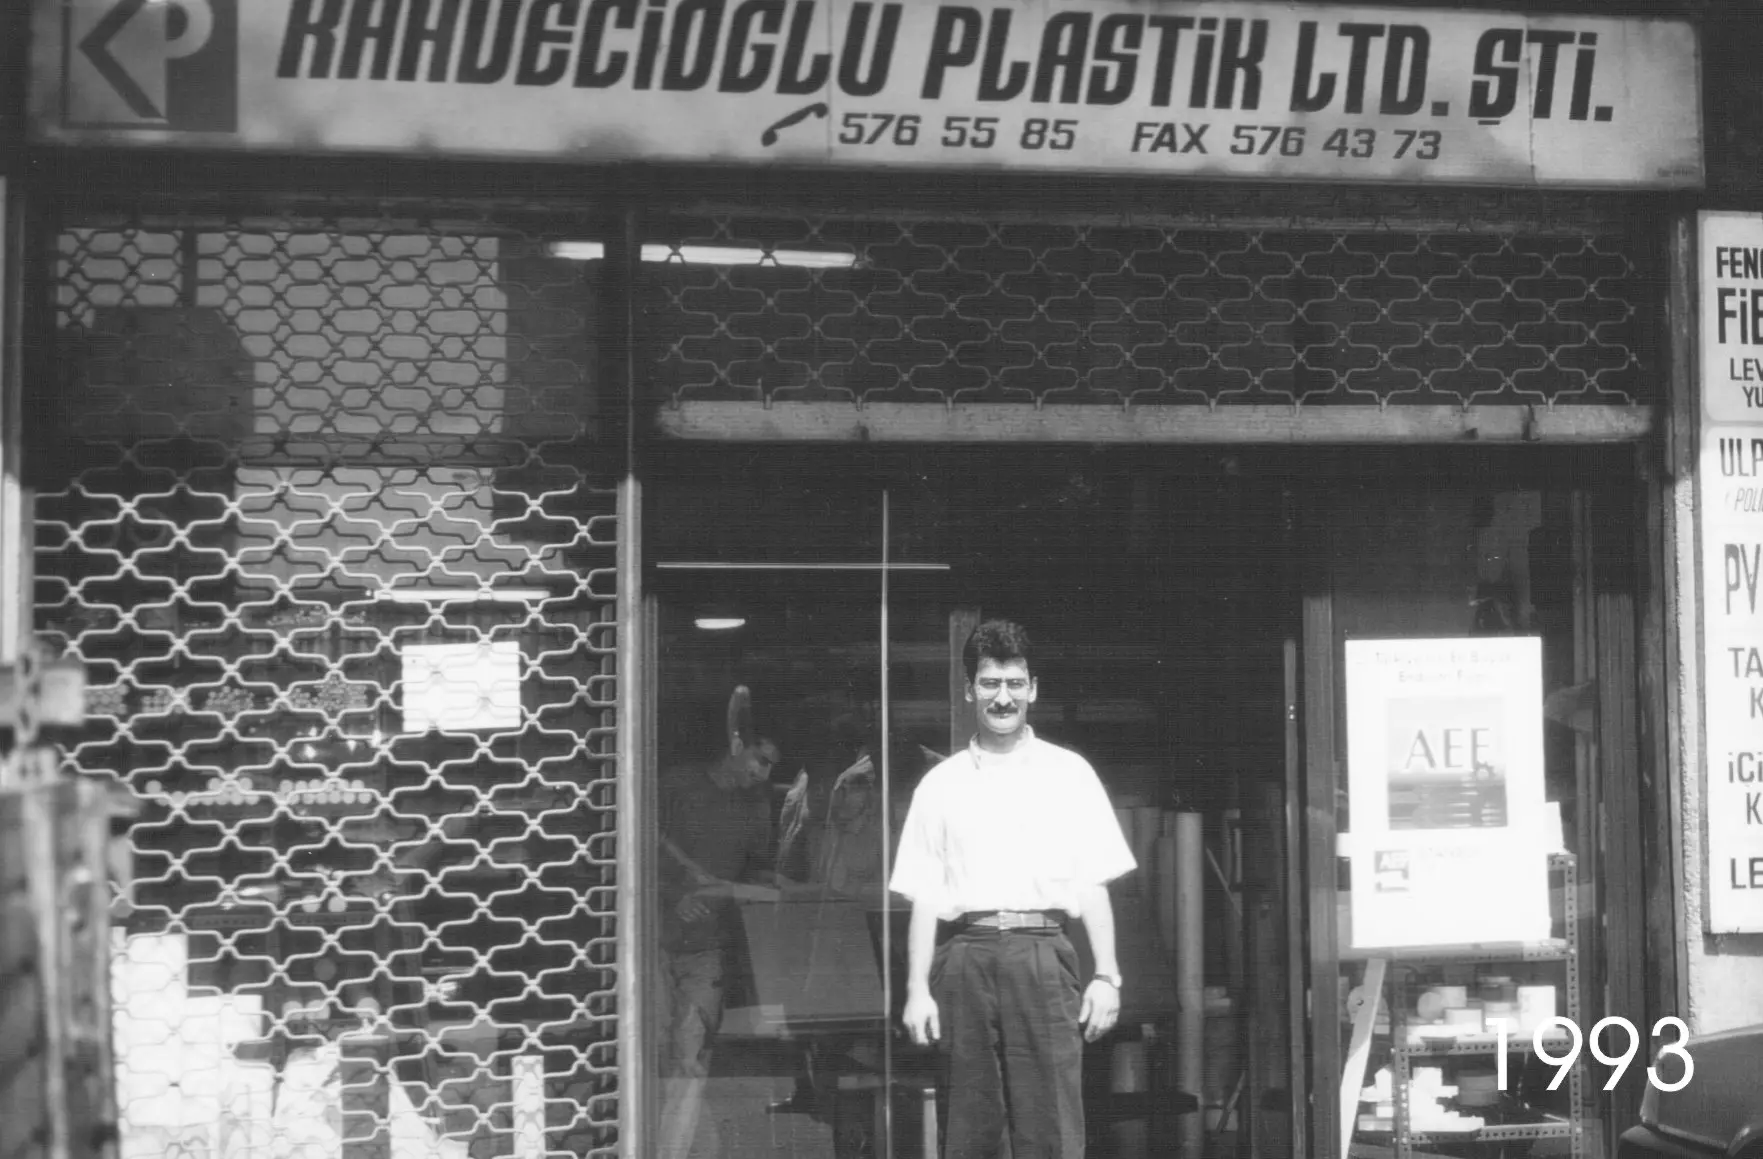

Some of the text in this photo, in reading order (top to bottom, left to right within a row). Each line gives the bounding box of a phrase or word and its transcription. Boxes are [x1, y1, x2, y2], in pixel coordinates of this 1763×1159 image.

[1289, 21, 1450, 116] LTD.
[839, 112, 1442, 160] 576 55 85 FAX 576 43 73
[1716, 246, 1763, 279] FEN
